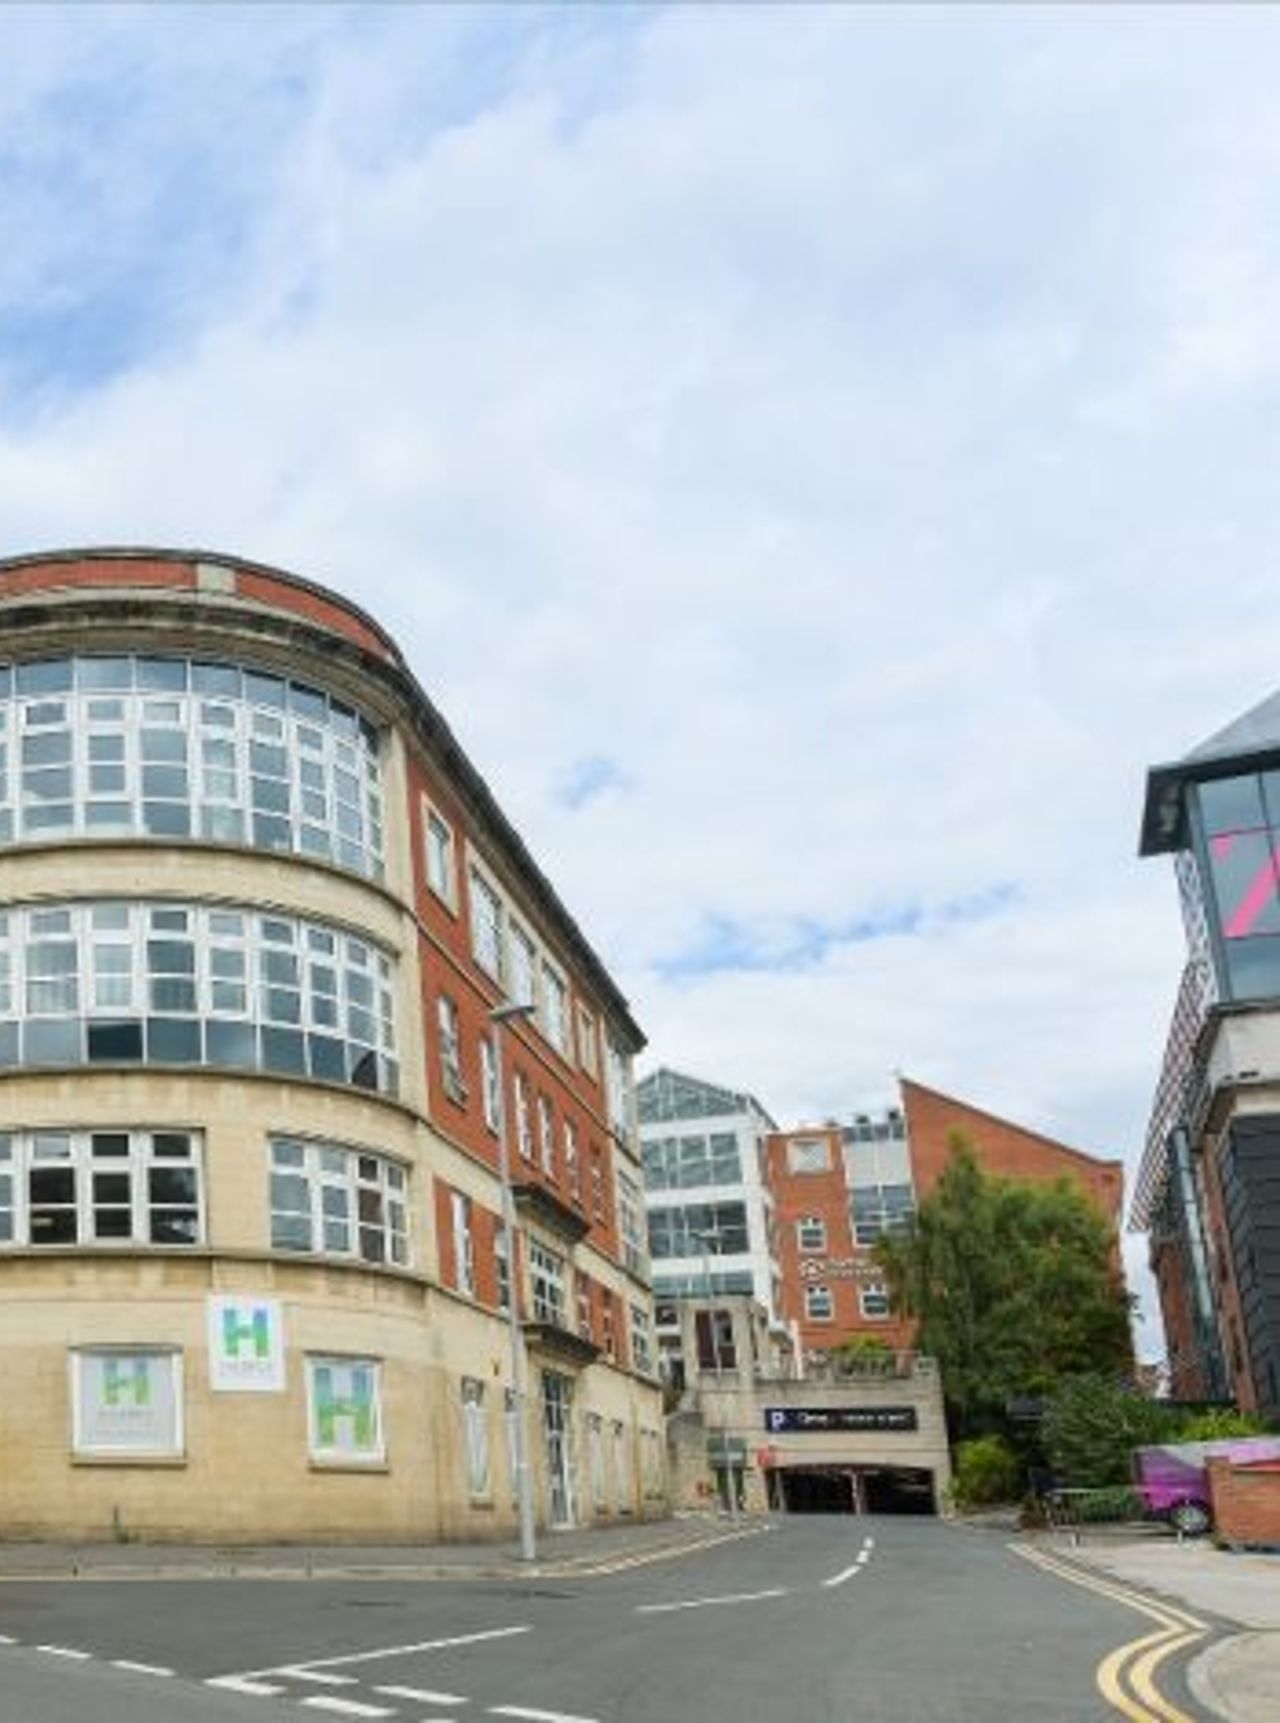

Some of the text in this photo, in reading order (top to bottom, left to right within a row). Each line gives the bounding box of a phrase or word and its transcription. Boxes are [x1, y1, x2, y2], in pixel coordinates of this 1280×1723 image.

[223, 1308, 269, 1357] H
[102, 1357, 152, 1405] H
[314, 1367, 372, 1447] H
[771, 1411, 785, 1430] P
